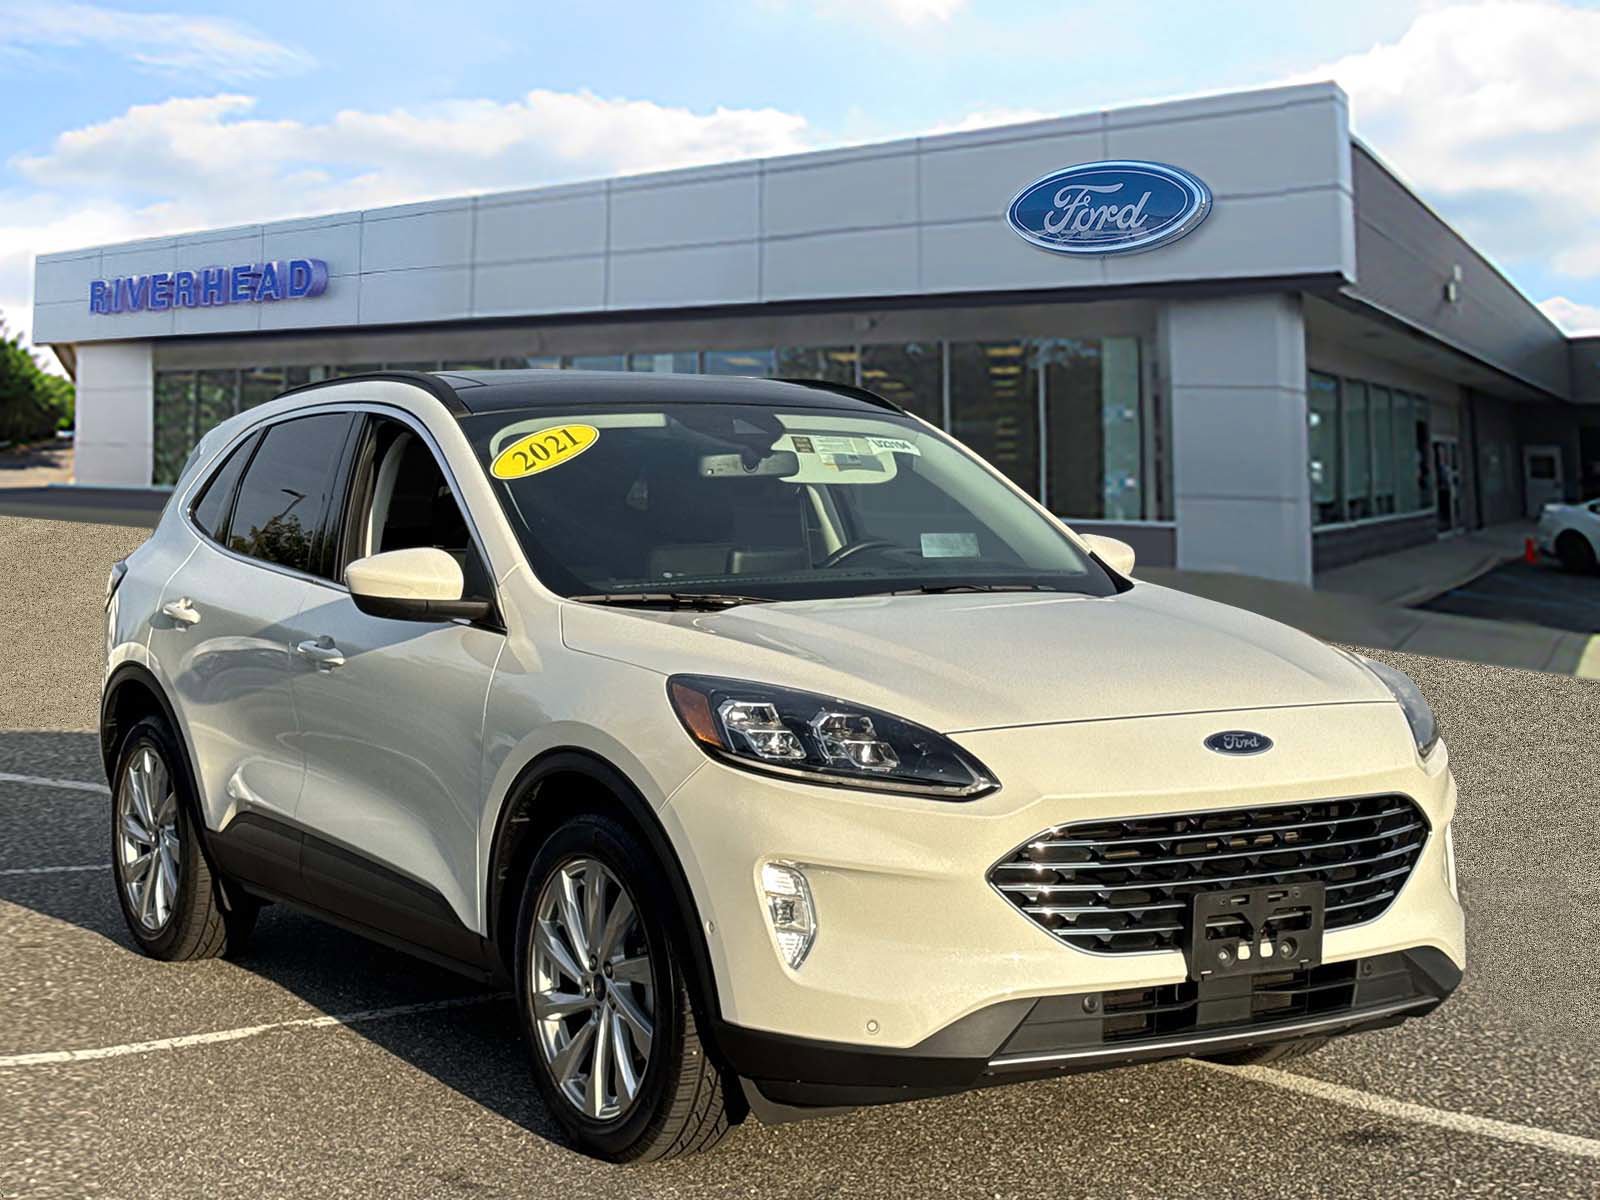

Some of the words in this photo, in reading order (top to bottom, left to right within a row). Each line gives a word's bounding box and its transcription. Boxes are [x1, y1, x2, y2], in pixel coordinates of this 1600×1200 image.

[1043, 183, 1152, 234] Ford
[90, 258, 324, 315] RIVERHEAD
[512, 429, 582, 471] 2021
[1223, 734, 1260, 749] Ford
